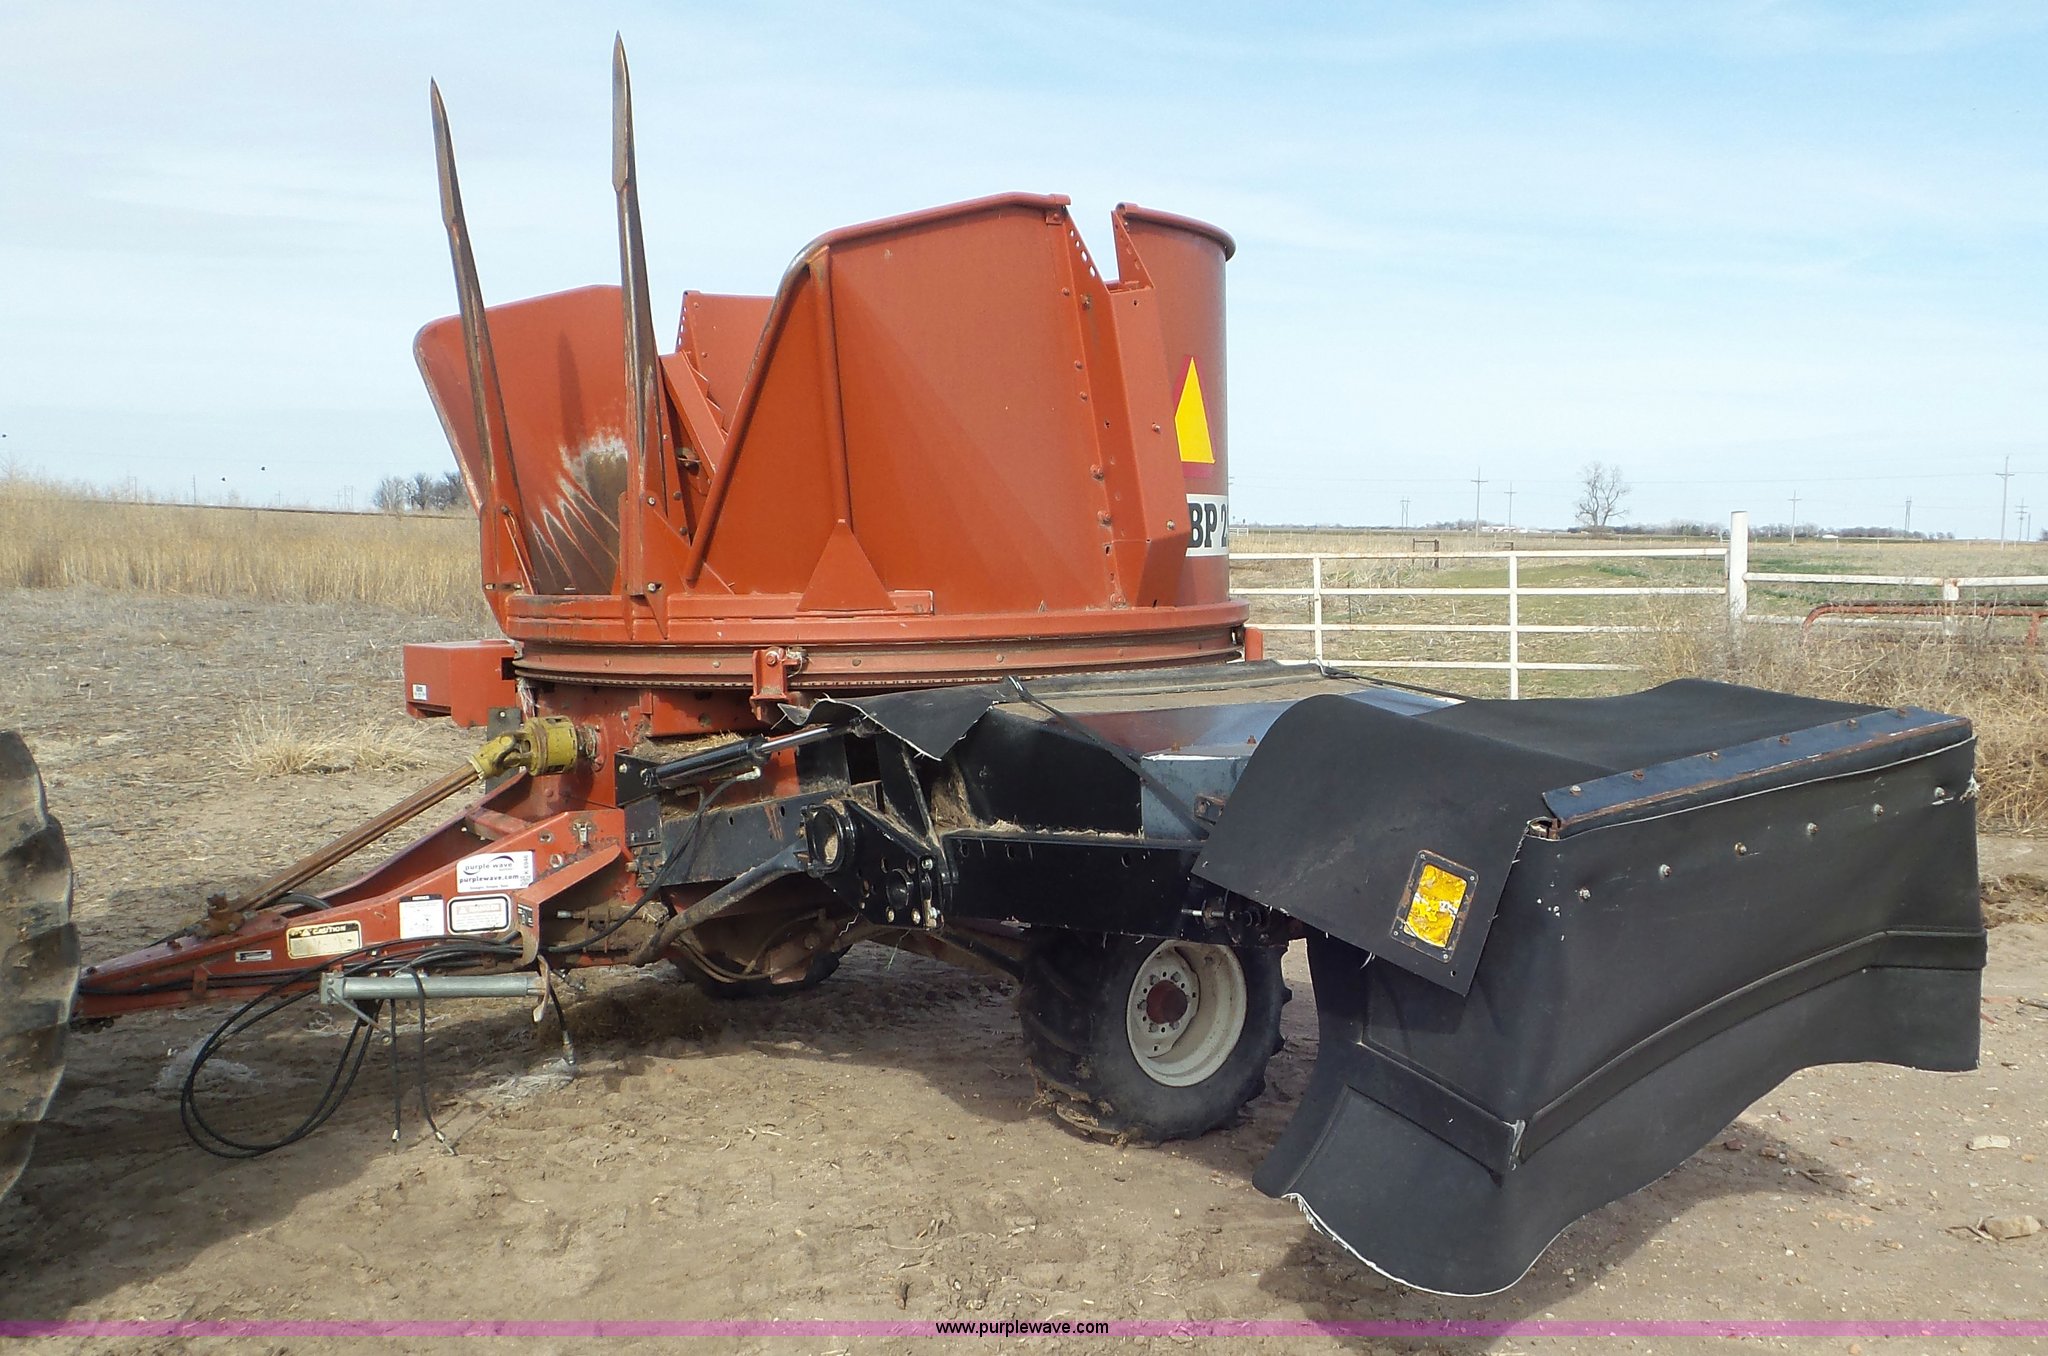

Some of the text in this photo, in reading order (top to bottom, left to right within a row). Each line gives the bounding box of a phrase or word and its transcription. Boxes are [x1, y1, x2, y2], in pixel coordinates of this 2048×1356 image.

[1188, 502, 1229, 548] BP 2
[465, 863, 490, 871] purple
[459, 875, 519, 884] purplewave.com
[312, 924, 347, 935] CAUTION
